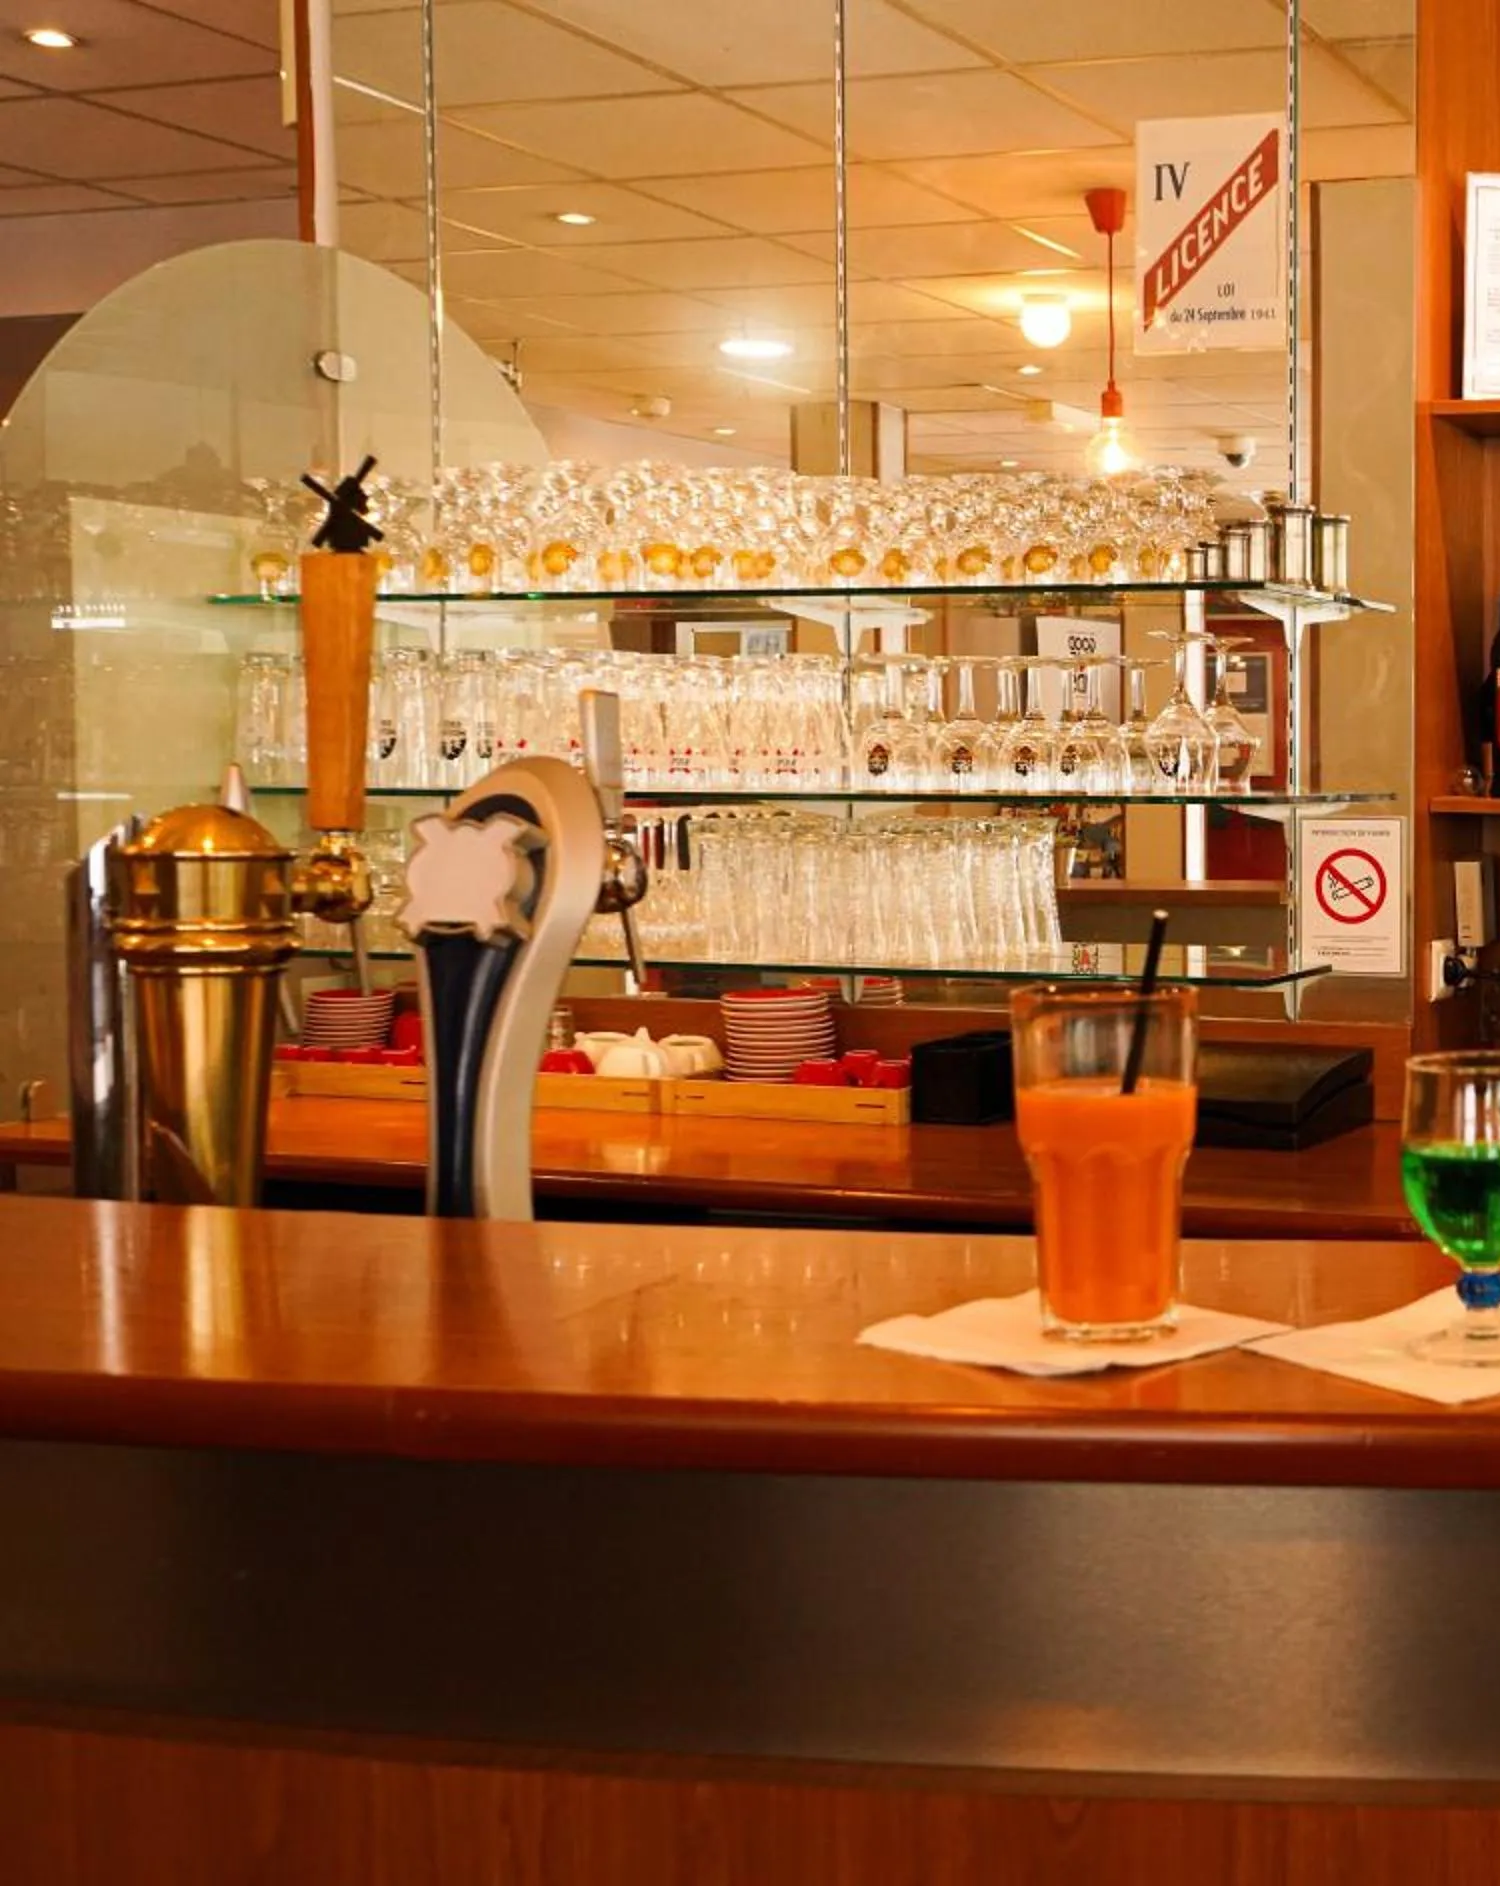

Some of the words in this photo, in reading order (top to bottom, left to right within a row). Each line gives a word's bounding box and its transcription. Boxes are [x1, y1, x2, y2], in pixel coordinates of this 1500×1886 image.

[1154, 162, 1190, 201] IV
[1155, 153, 1264, 301] LICENCE
[1216, 282, 1235, 298] LOI
